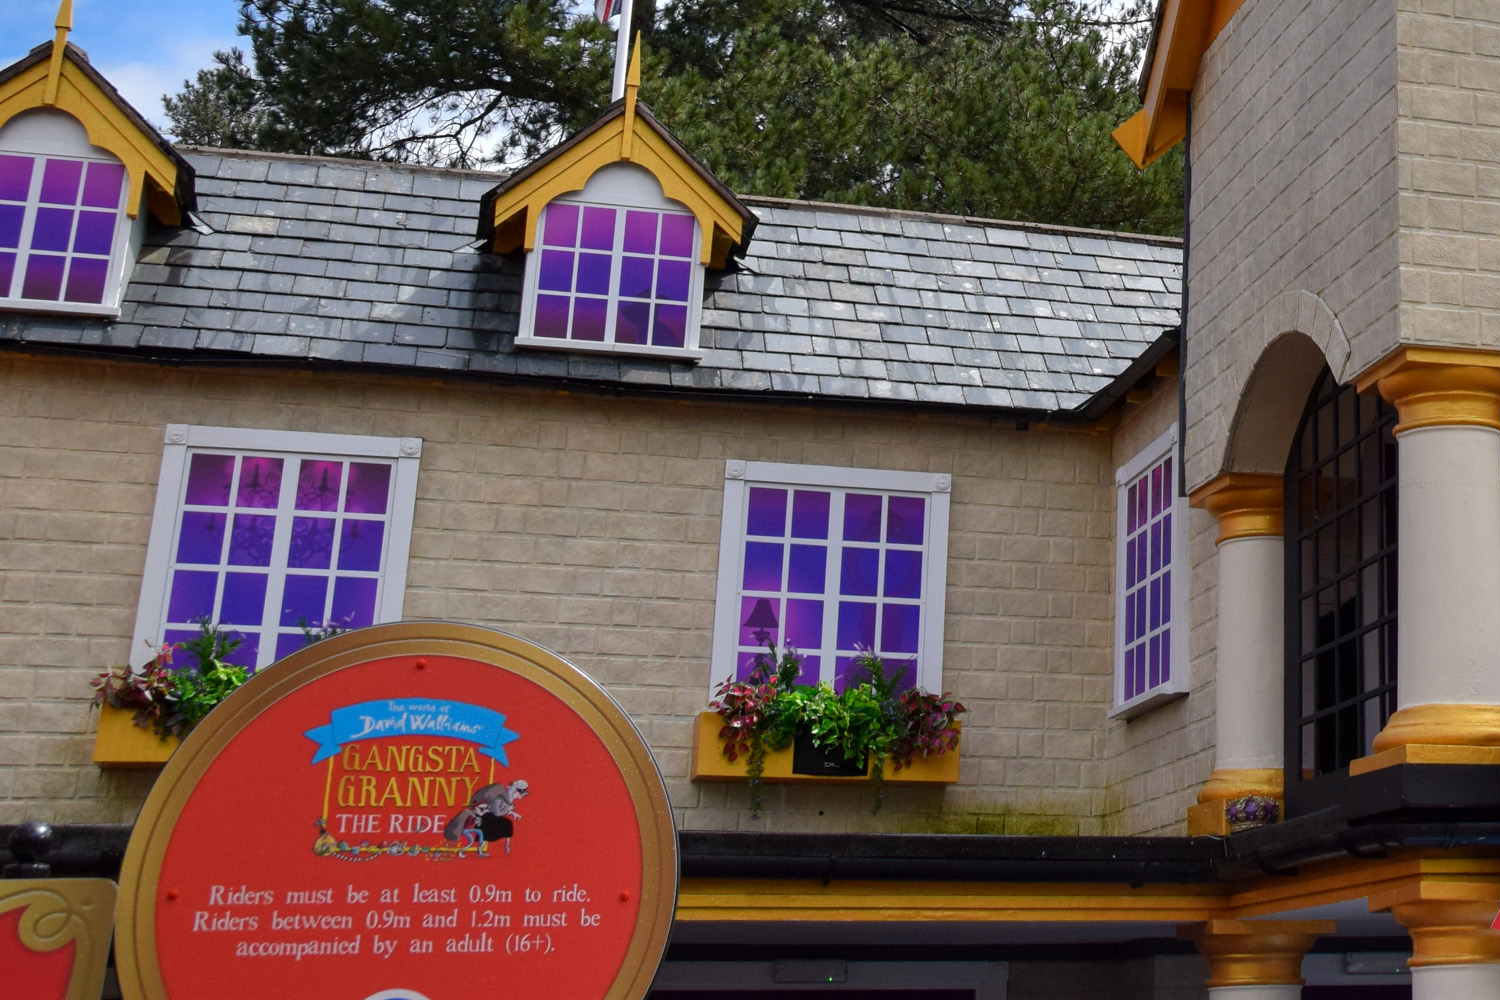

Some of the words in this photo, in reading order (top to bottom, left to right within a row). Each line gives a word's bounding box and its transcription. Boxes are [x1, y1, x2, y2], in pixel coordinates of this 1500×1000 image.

[389, 702, 405, 712] The
[409, 704, 436, 713] world
[440, 704, 452, 713] of
[351, 713, 407, 738] David
[410, 715, 481, 734] Walliams
[342, 744, 482, 773] GANGSTA
[337, 775, 480, 807] GRANNY
[336, 814, 381, 833] THE
[388, 814, 447, 833] RIDE
[208, 885, 274, 905] Riders
[286, 888, 334, 904] must
[347, 885, 369, 903] be
[380, 888, 400, 903] at
[413, 883, 457, 903] least
[469, 885, 512, 903] 0.9m
[525, 887, 542, 902] to
[553, 884, 591, 902] ride.
[193, 911, 259, 931] Riders
[271, 911, 353, 930] between
[366, 910, 411, 928] 0.9m
[422, 909, 458, 927] and
[471, 910, 511, 927] 1.2m
[523, 912, 567, 927] must
[580, 908, 601, 926] be
[236, 935, 361, 960] accompanied
[373, 935, 398, 959] by
[410, 939, 433, 953] an
[446, 933, 494, 953] adult
[506, 934, 555, 955] (16+).
